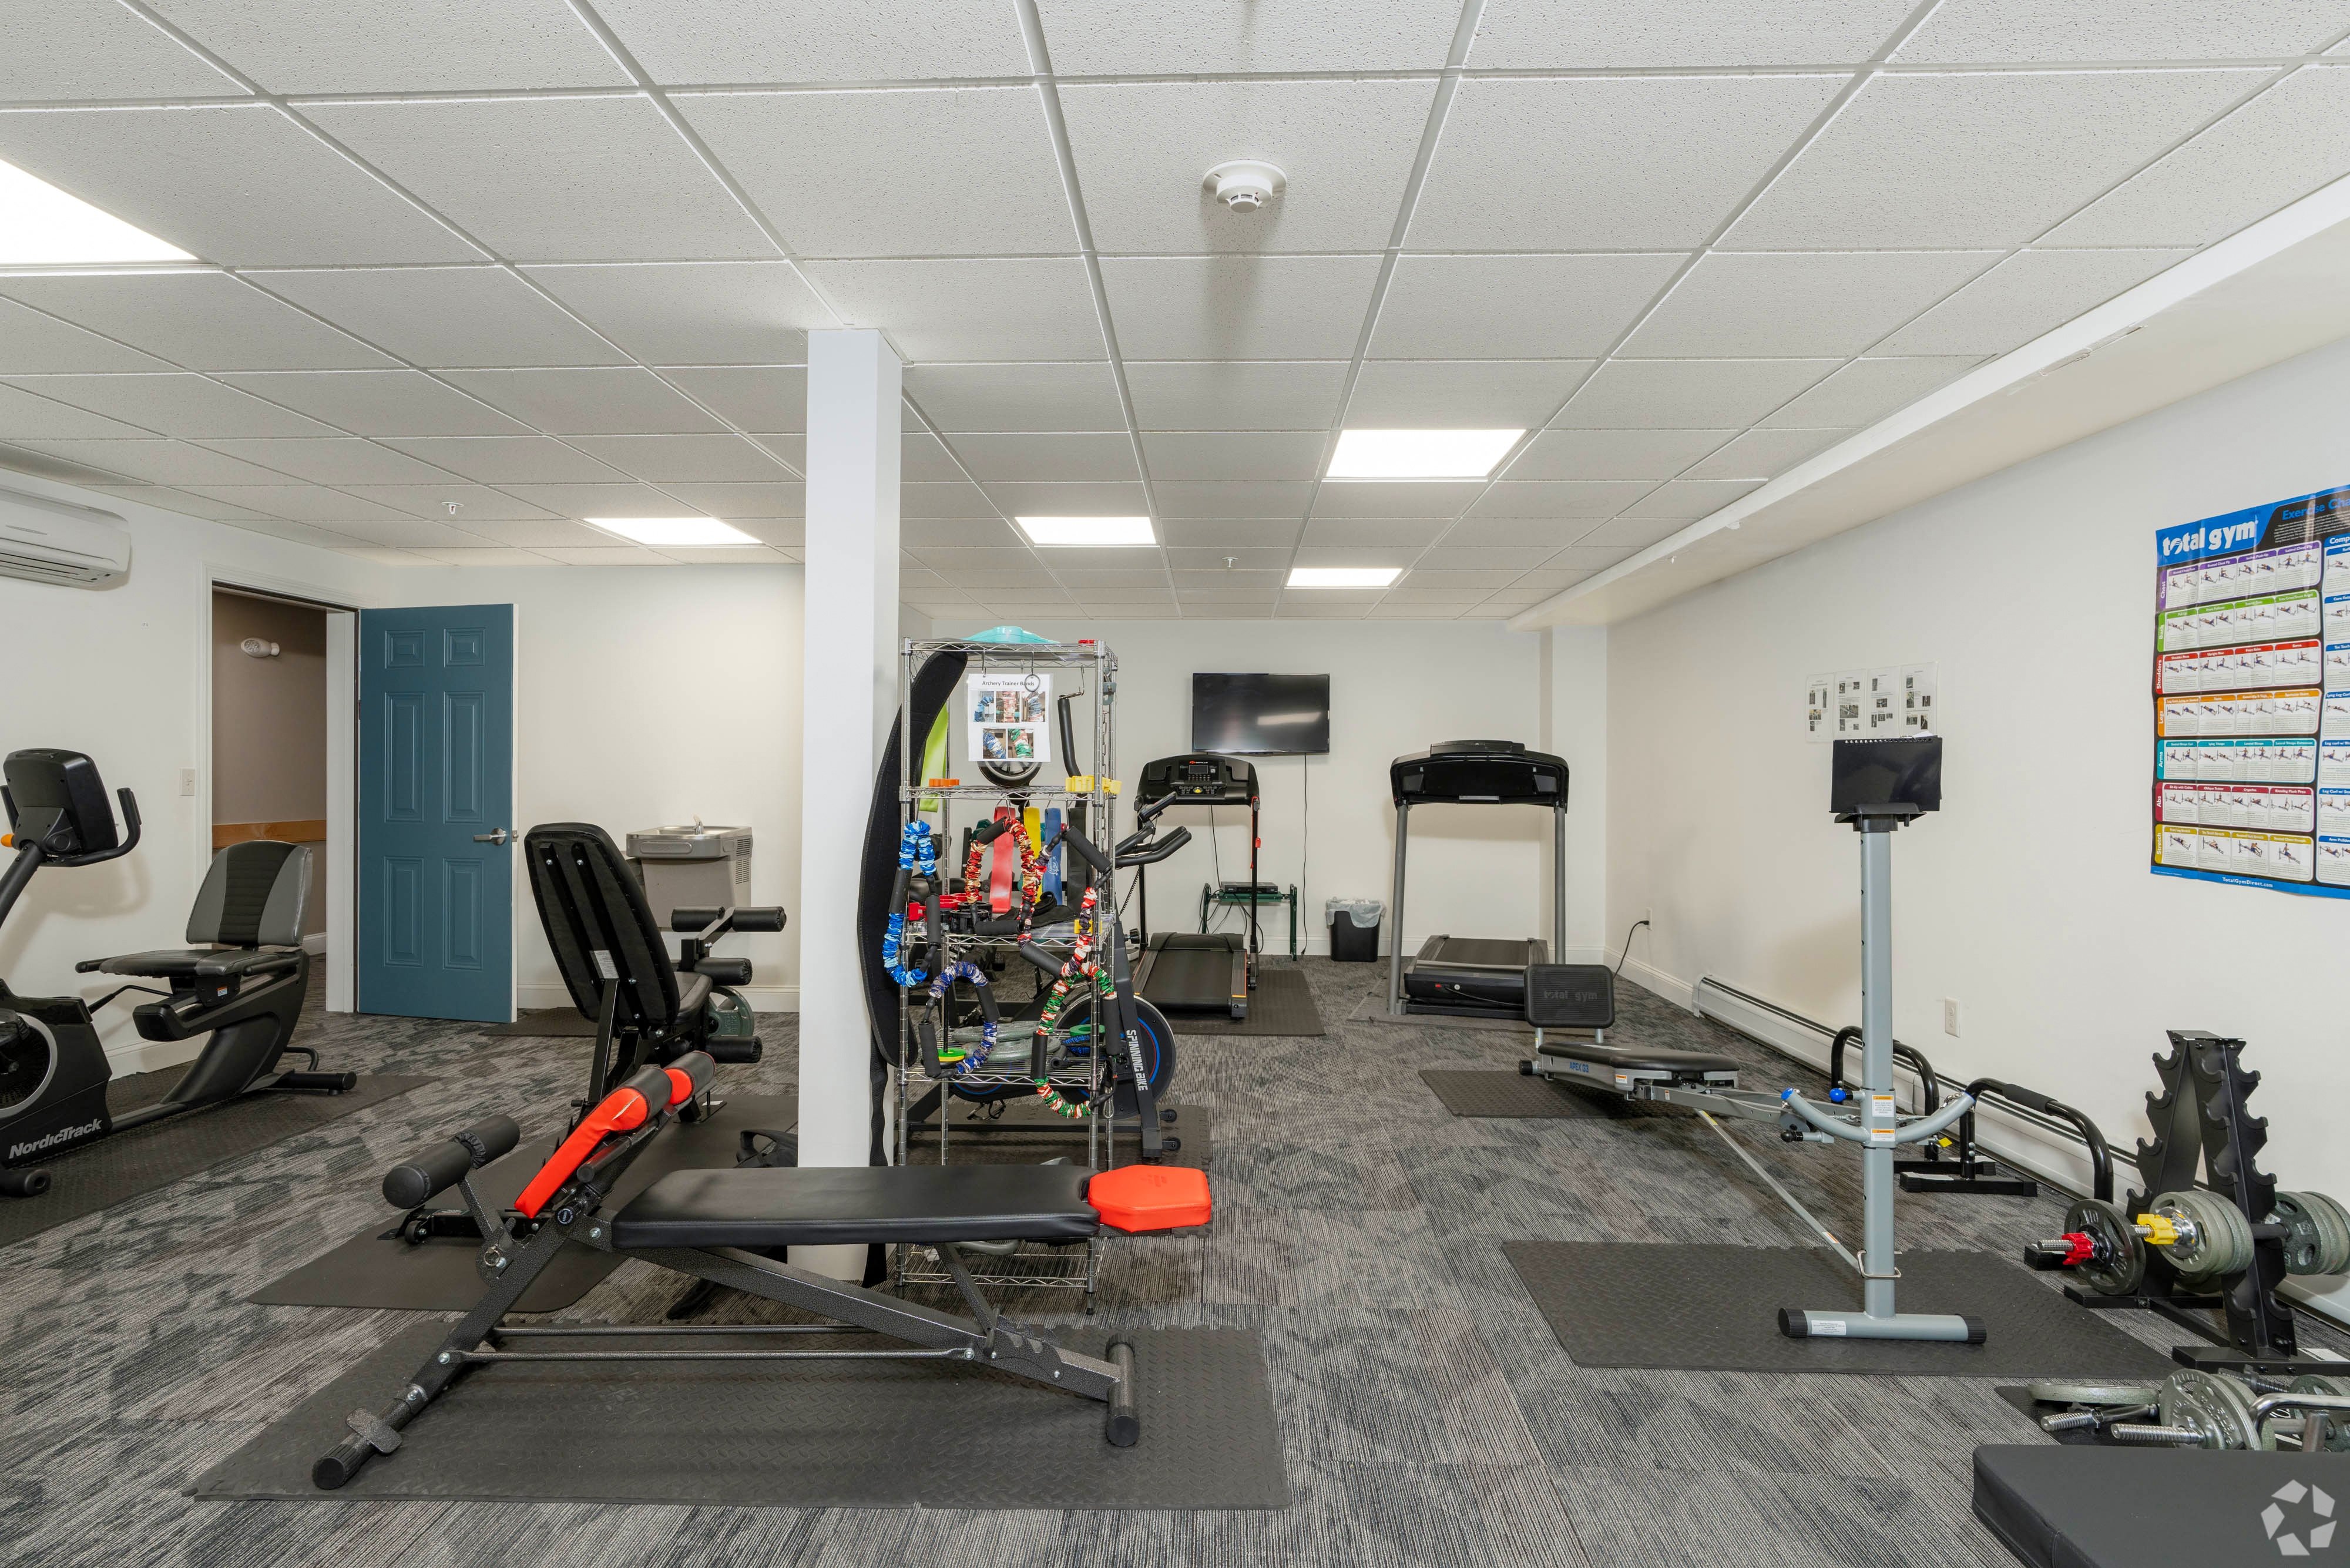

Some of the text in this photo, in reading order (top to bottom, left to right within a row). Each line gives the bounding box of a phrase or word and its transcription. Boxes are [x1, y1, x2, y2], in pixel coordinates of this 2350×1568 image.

[2282, 503, 2325, 521] Exercise
[2163, 527, 2205, 556] total
[2208, 520, 2256, 550] gym
[2222, 877, 2273, 888] TotalGymDirect.com
[1574, 992, 1597, 1002] gym
[1126, 1029, 1148, 1091] SPINNING BIKE
[1569, 1062, 1589, 1073] APEX G3
[9, 1119, 102, 1159] NordicTrack
